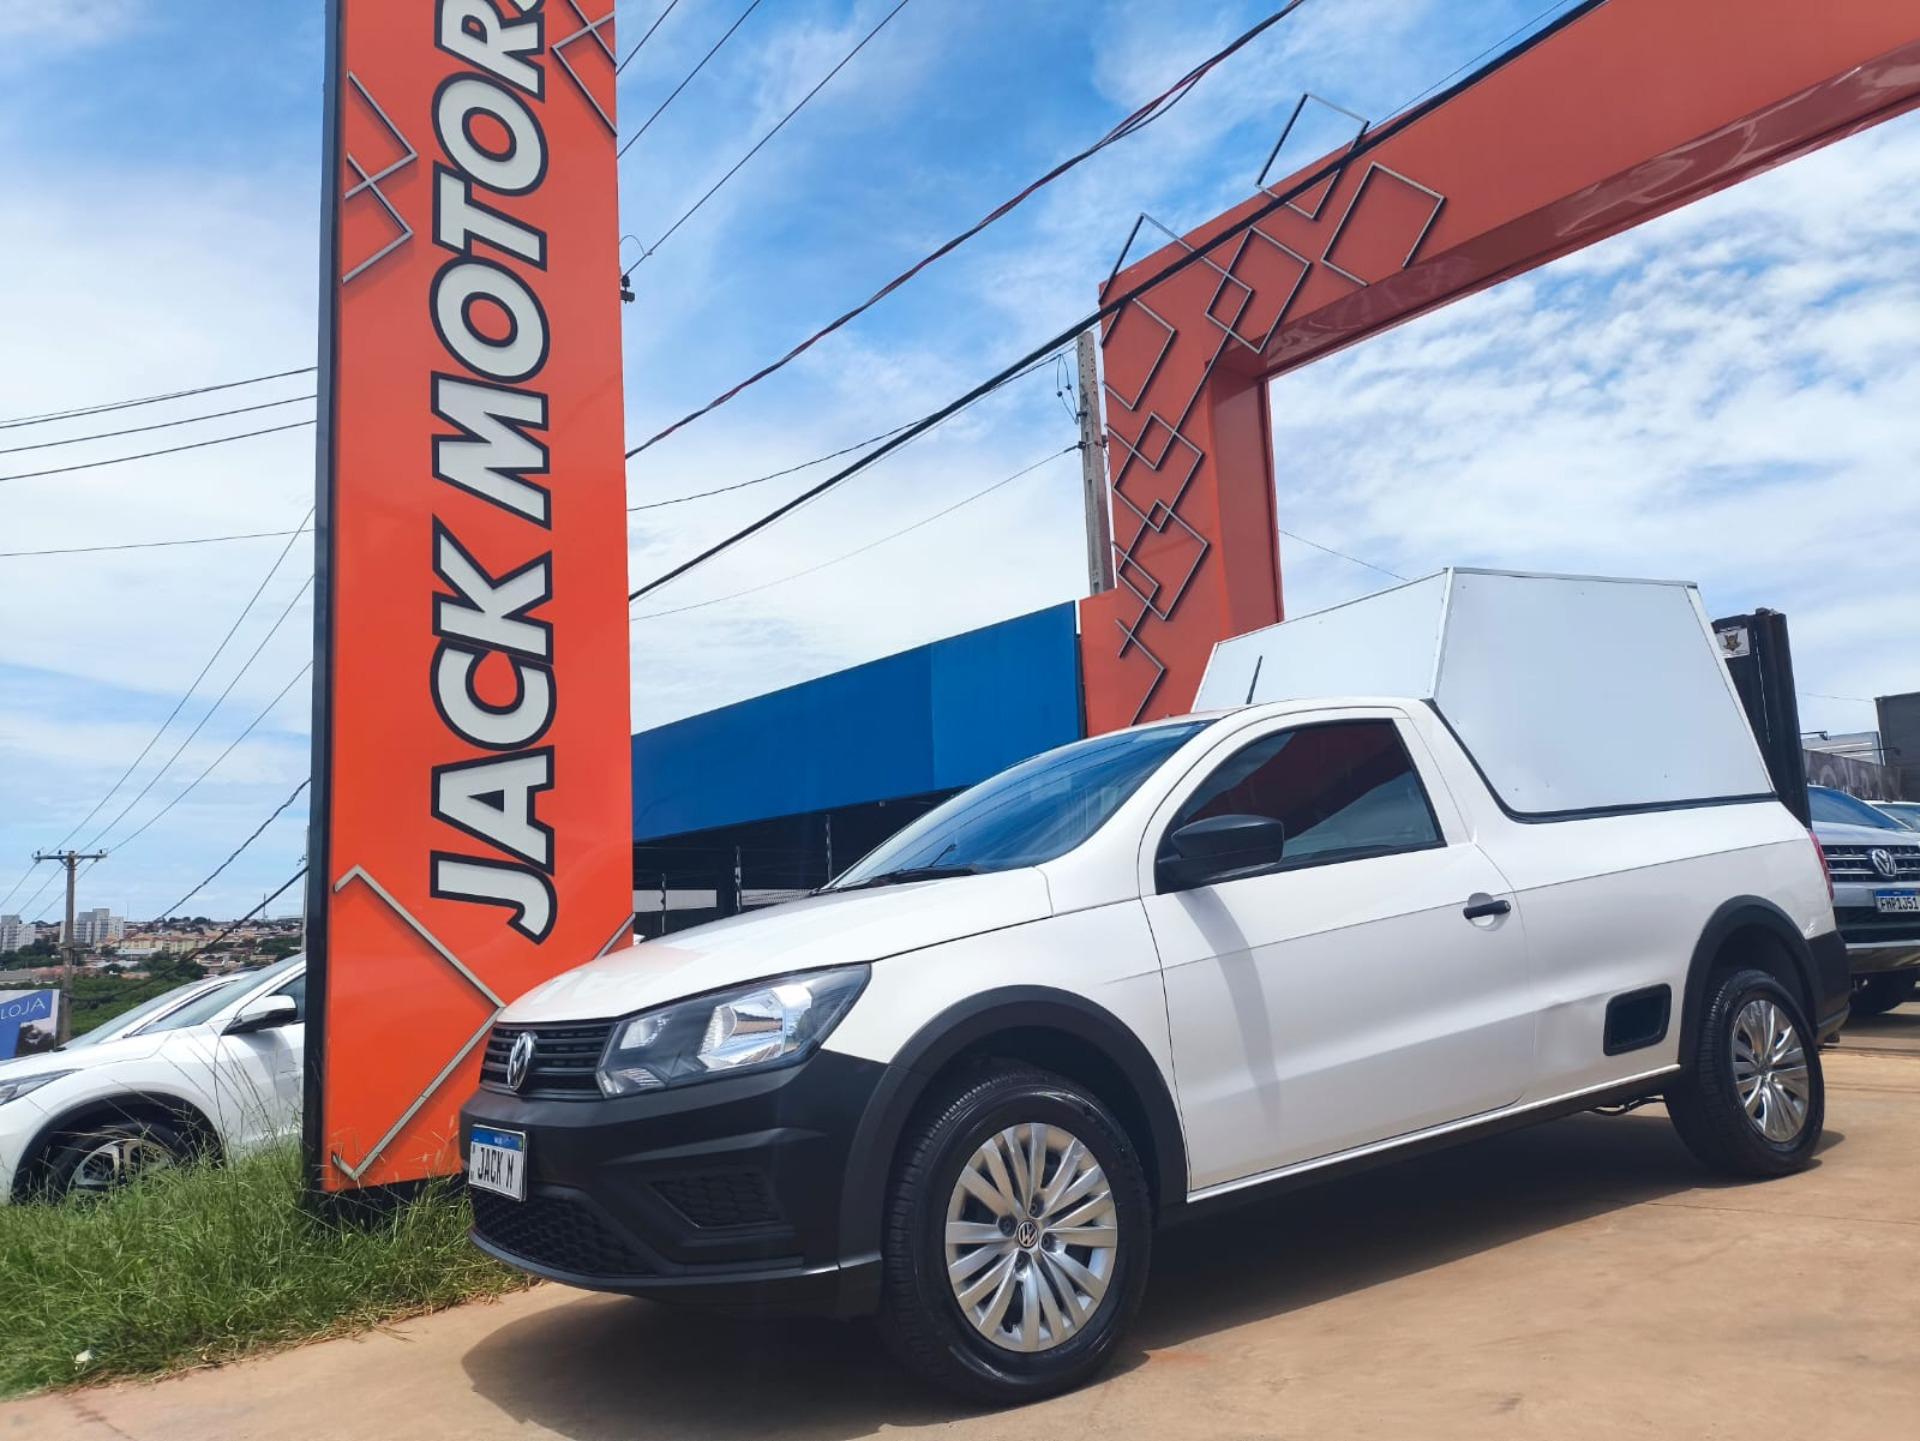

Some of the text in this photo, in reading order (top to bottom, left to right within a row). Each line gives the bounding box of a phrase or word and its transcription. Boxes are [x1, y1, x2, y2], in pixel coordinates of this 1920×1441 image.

[430, 0, 557, 945] JACK MOTOR
[1, 997, 46, 1020] LOJA
[478, 1146, 503, 1187] JACK
